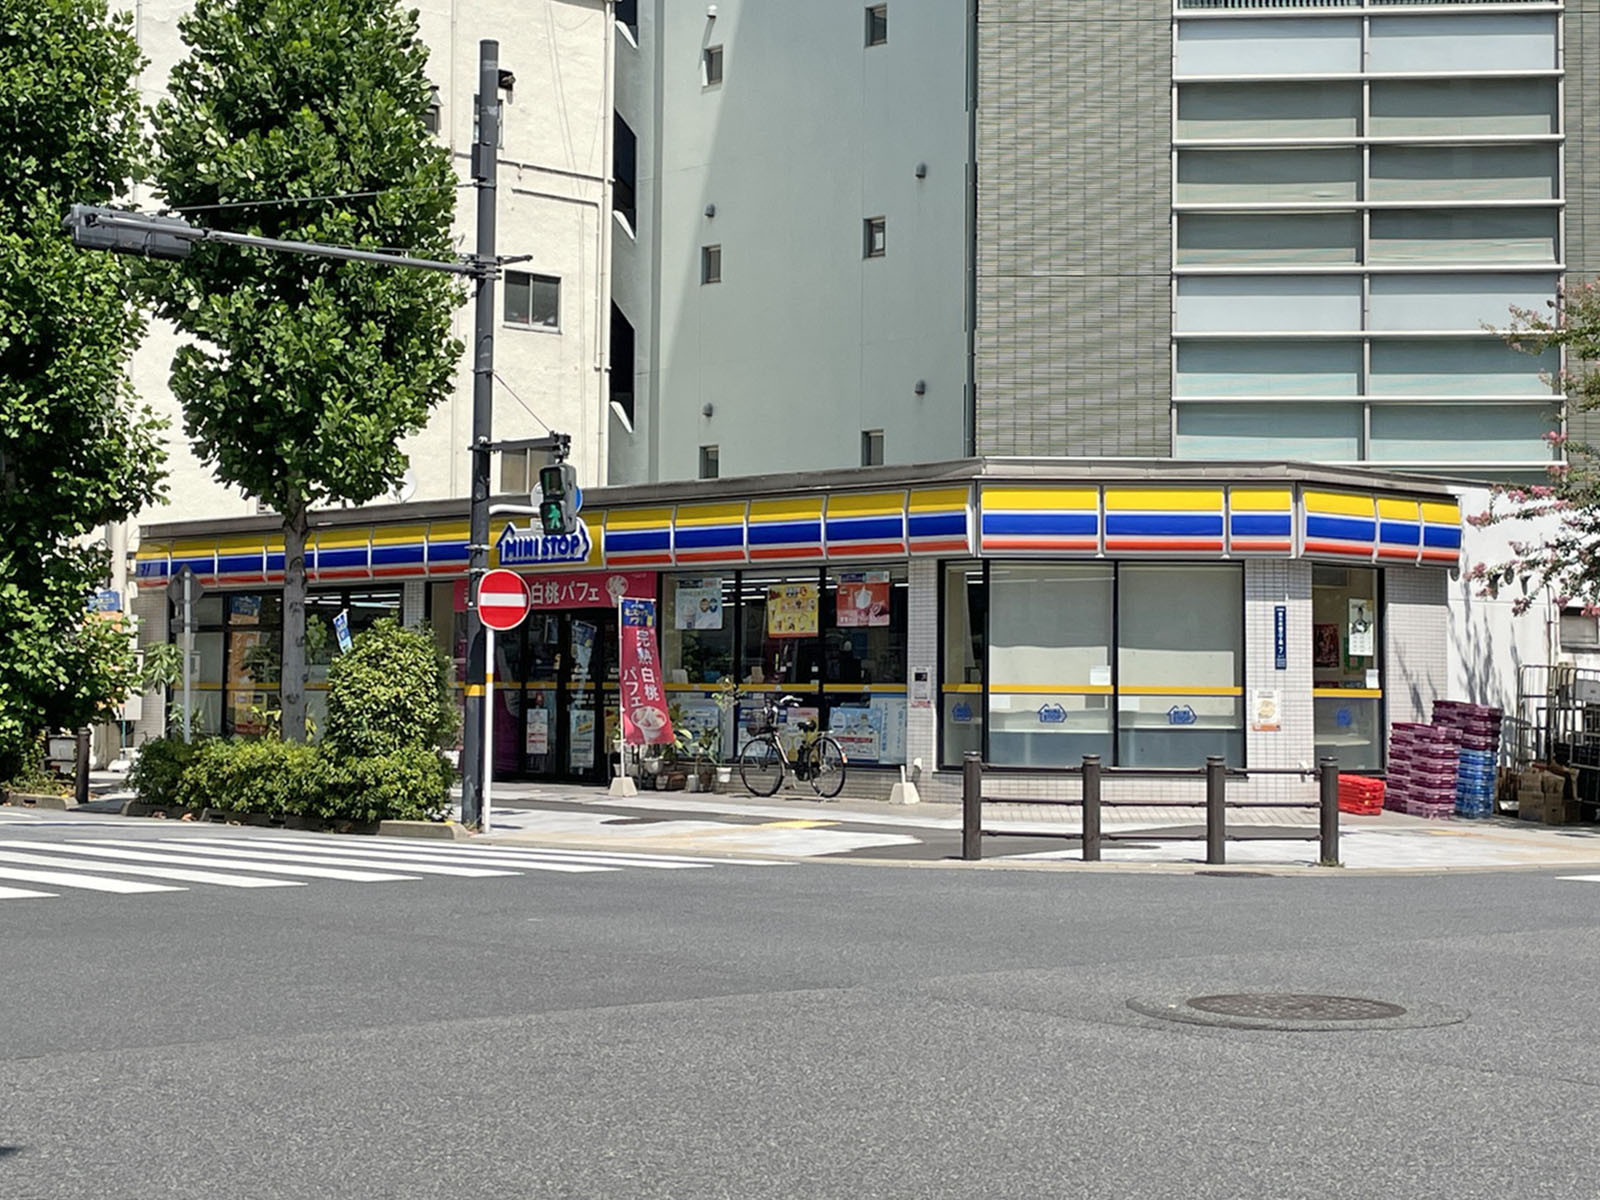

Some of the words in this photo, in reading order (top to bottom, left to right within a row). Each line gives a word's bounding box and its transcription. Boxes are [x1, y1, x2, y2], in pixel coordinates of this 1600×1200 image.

[503, 536, 540, 558] MINI
[541, 533, 580, 556] STOP
[531, 582, 600, 605] 白桃パフェ
[623, 666, 644, 708] パフェ
